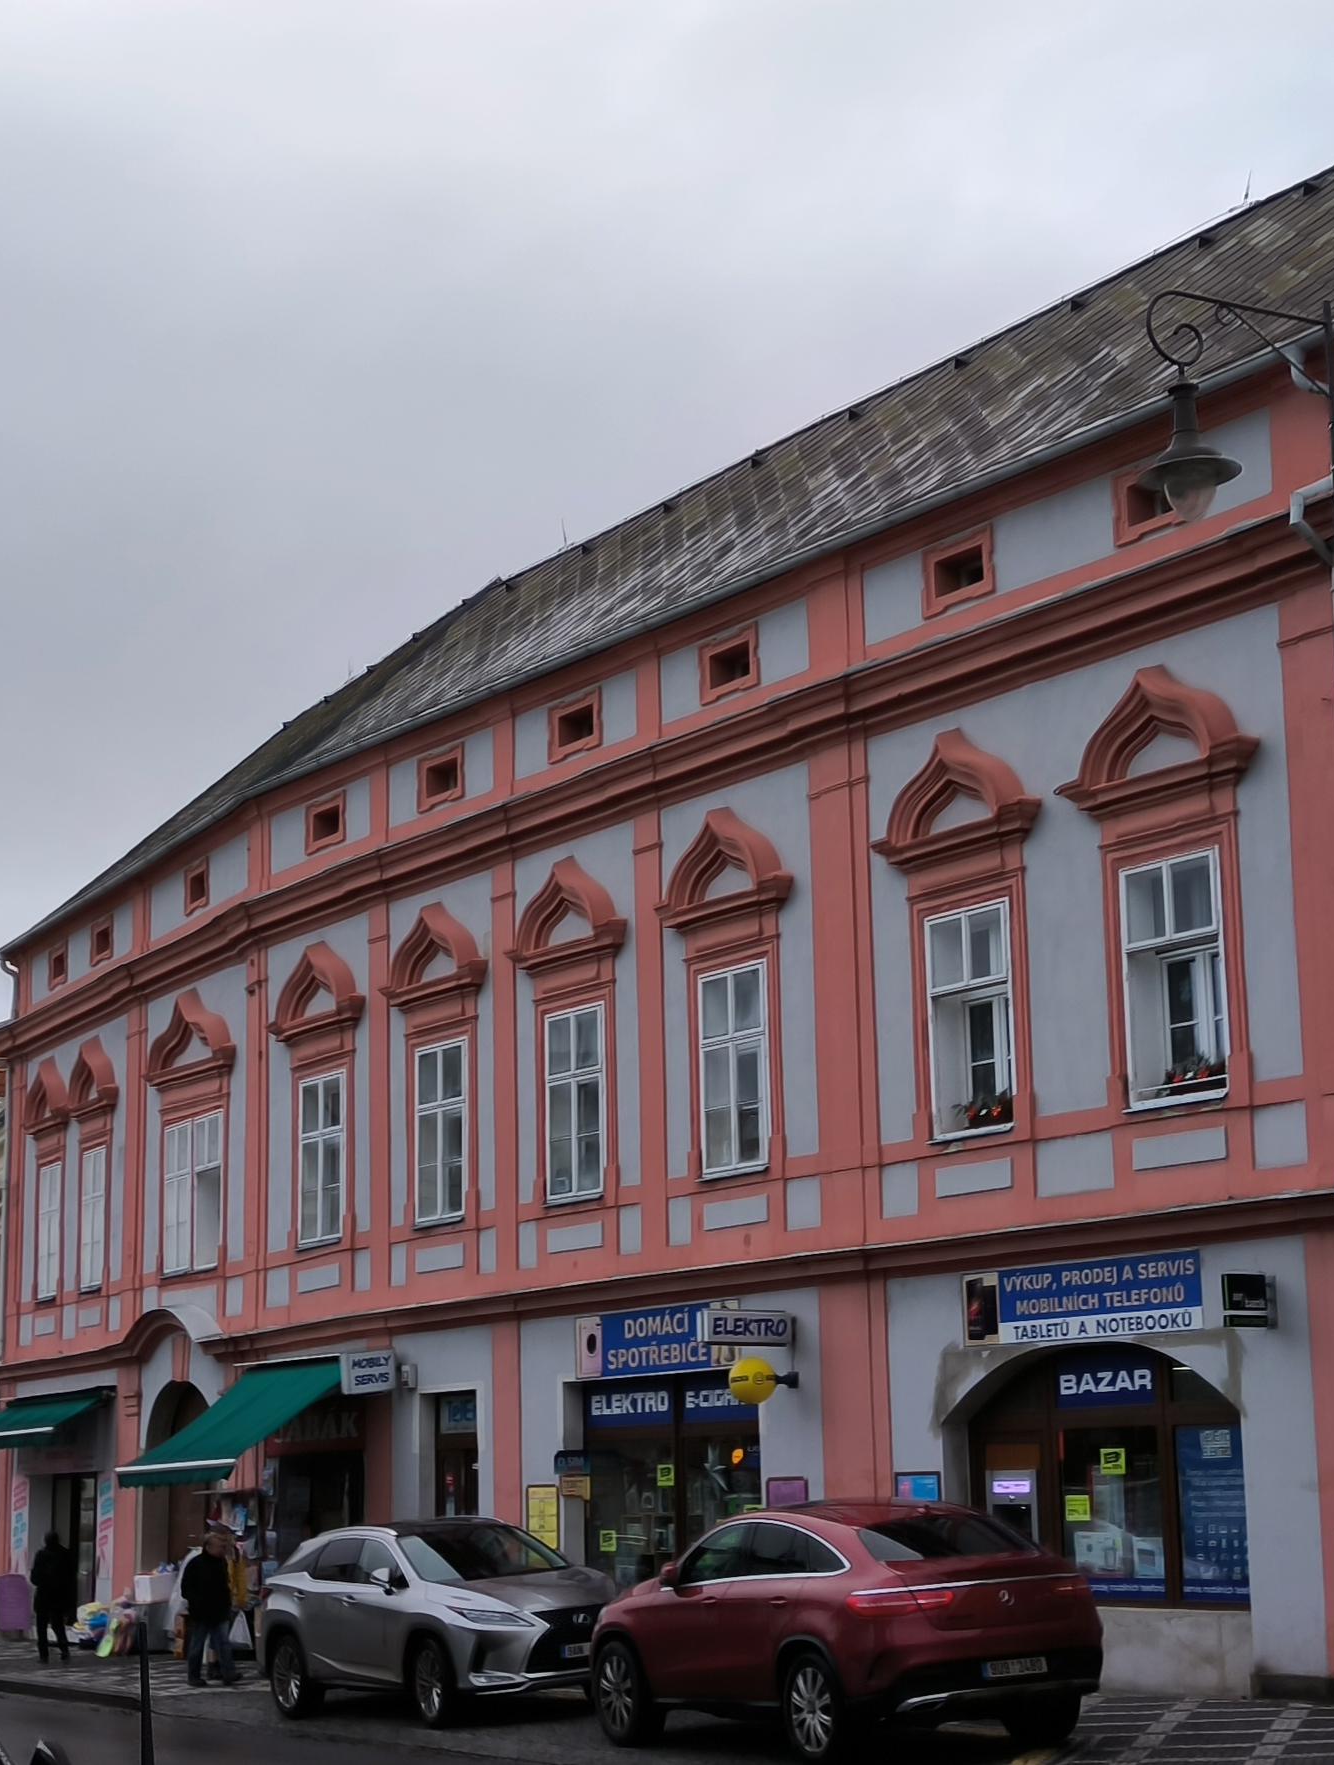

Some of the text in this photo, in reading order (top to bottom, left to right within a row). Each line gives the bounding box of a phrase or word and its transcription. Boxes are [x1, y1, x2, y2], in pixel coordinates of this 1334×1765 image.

[1003, 1258, 1195, 1293] VÝKUP, PRODEJ A SERVIS
[1015, 1282, 1185, 1316] MOBILNÍCH TELEFONŮ
[623, 1308, 690, 1339] DOMÁCÍ
[713, 1317, 788, 1337] ELEKTRO
[1014, 1309, 1193, 1341] TABLETŮ A NOTEBOOKŮ
[351, 1354, 392, 1370] MOBILY
[607, 1336, 709, 1371] SPOTŘEBIČE
[354, 1372, 390, 1387] SERVIS
[1058, 1368, 1153, 1397] BAZAR
[591, 1390, 669, 1417] ELEKTRO
